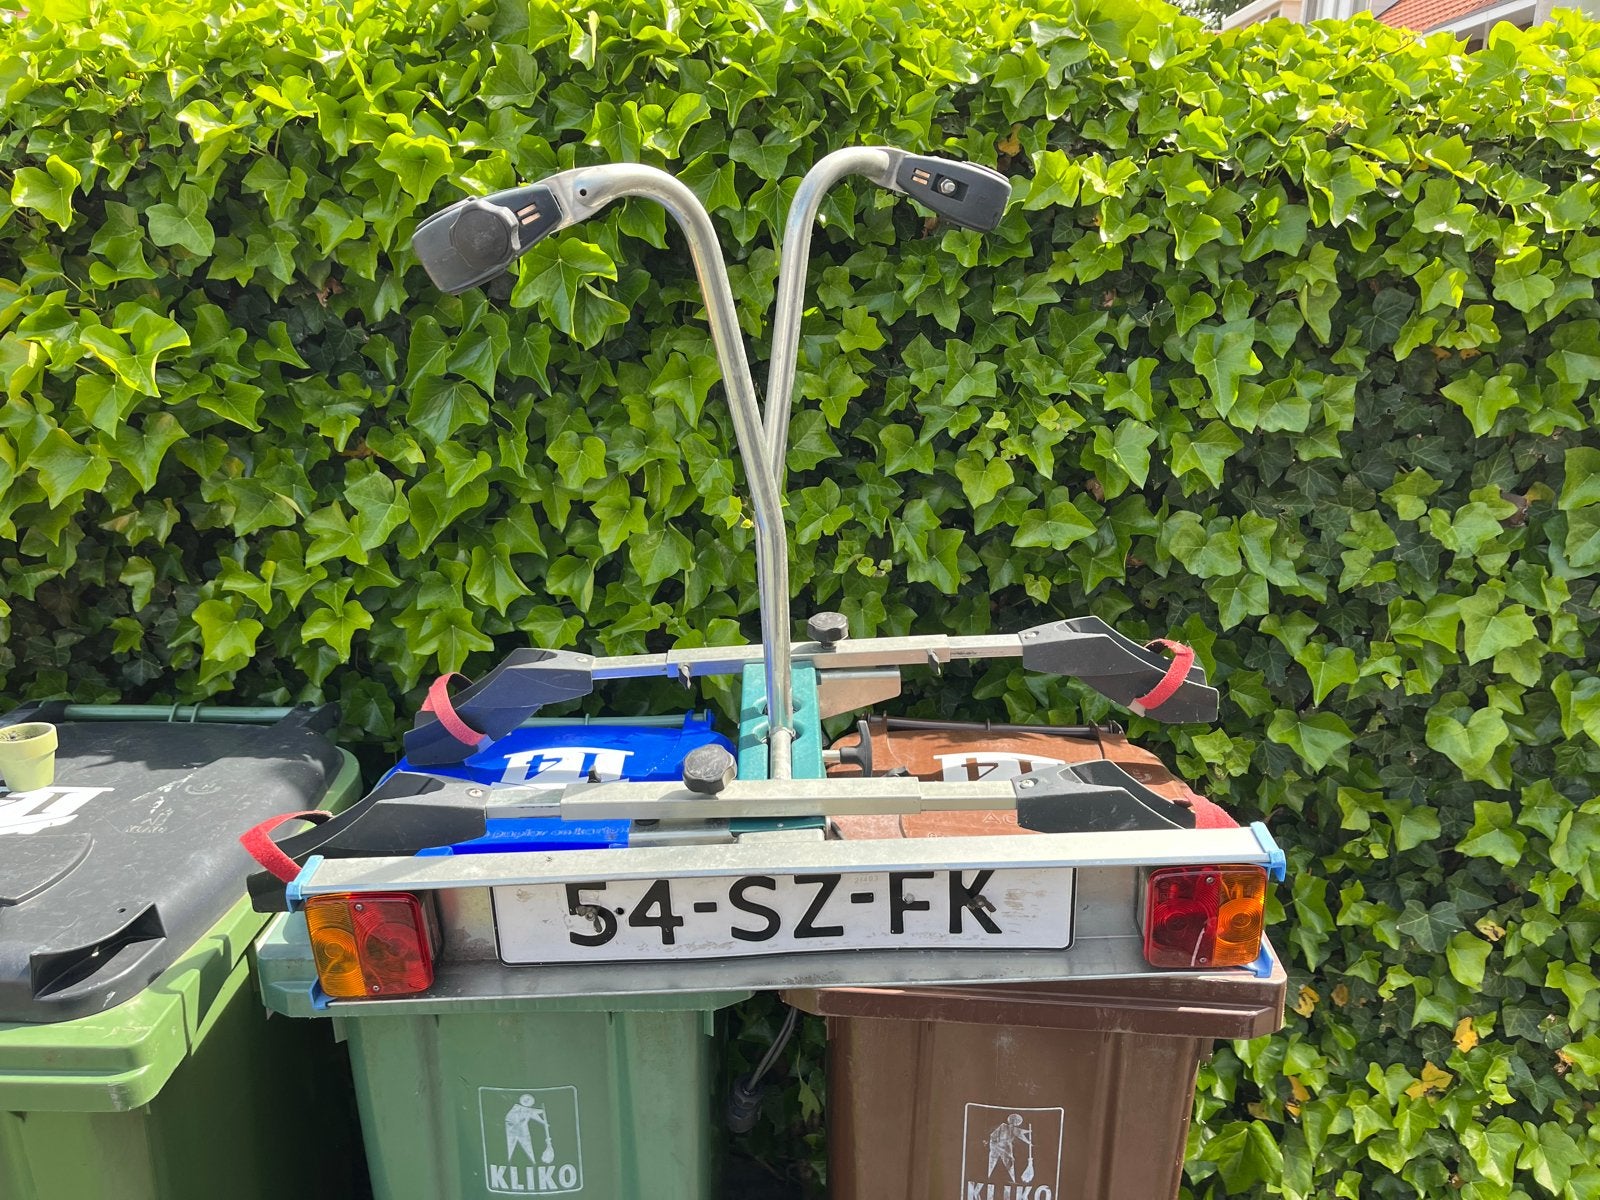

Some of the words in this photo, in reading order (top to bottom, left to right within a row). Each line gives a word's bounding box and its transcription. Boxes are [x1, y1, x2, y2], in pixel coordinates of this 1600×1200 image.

[524, 752, 597, 781] 14
[567, 870, 1003, 946] 54-SZ-FK
[490, 1164, 577, 1190] KLIKO
[967, 1181, 1052, 1200] KLIKO
